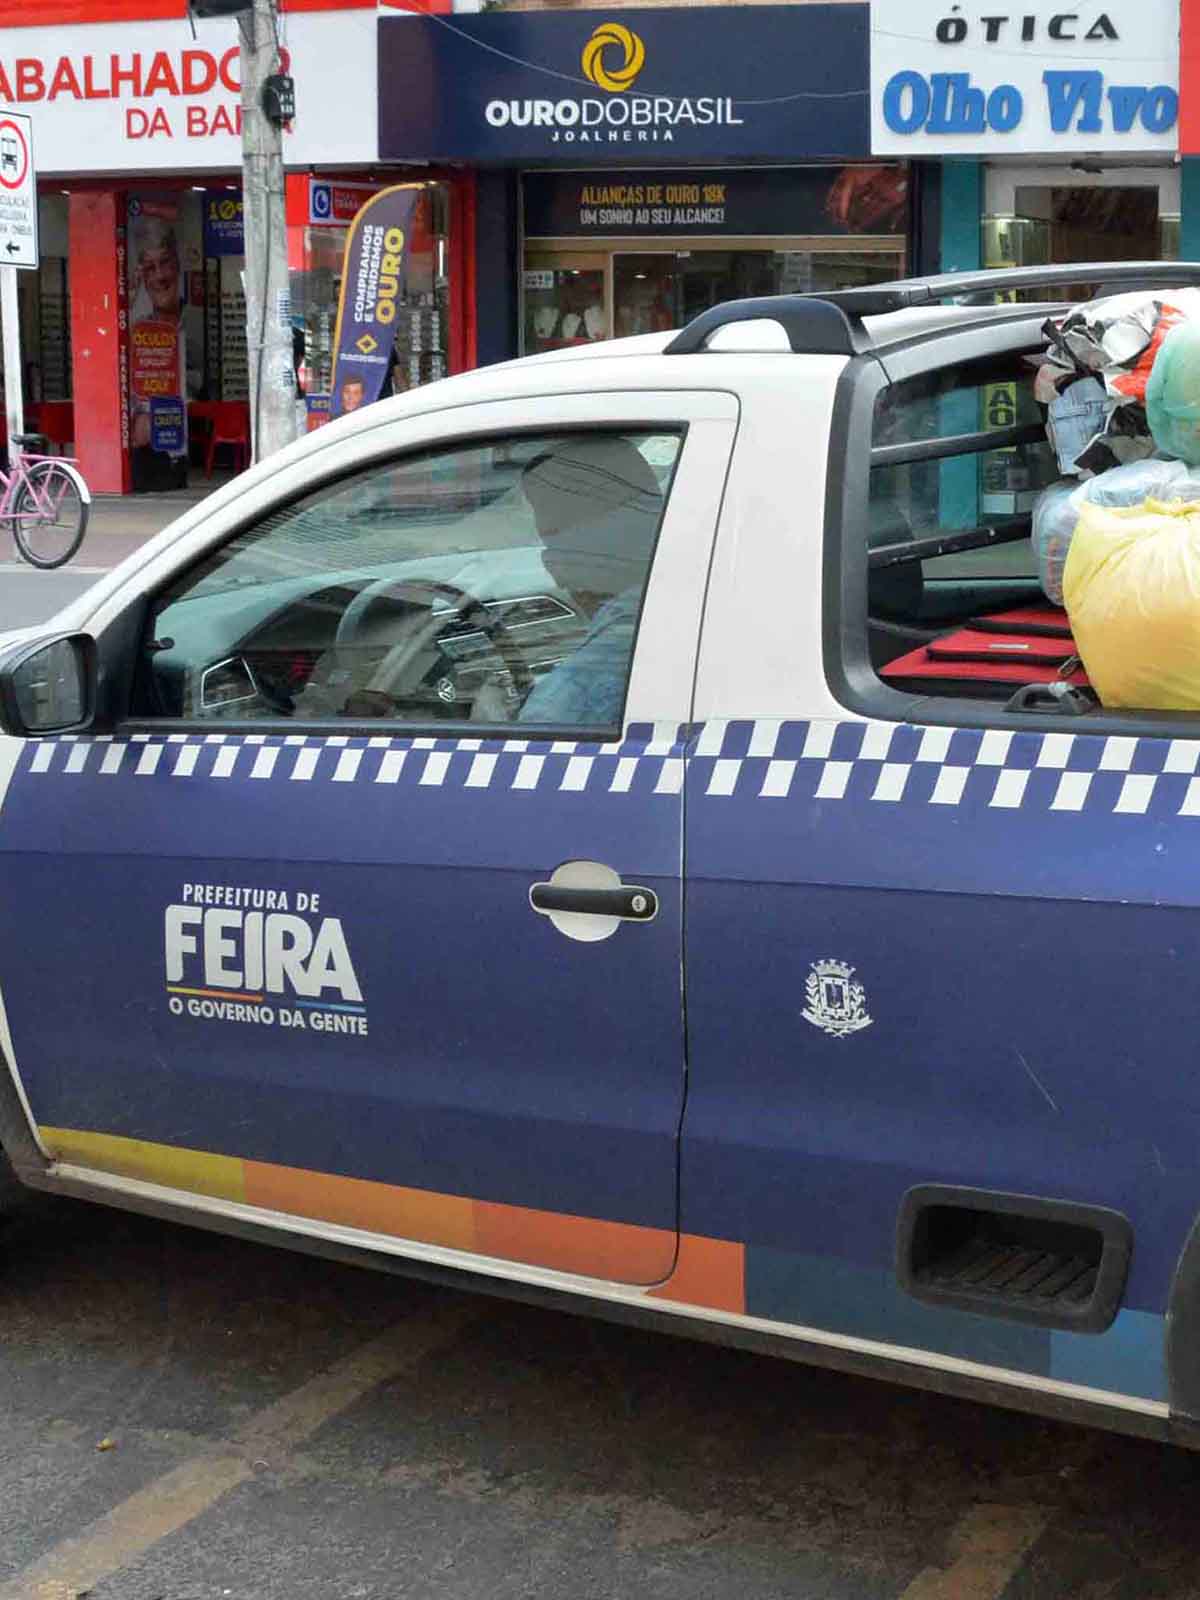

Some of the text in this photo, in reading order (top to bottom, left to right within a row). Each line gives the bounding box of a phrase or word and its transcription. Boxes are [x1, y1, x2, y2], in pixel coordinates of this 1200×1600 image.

[935, 5, 1119, 43] ÓTICA
[883, 69, 1025, 135] Olho
[126, 108, 173, 139] DA
[551, 129, 674, 142] JOALHERIA
[646, 186, 662, 203] DE
[666, 186, 699, 204] OURO
[354, 224, 374, 323] COMPRAMOS
[366, 226, 385, 310] VENDEMOS
[375, 227, 405, 325] OURO
[183, 883, 321, 913] PREFEITURA DE
[164, 904, 364, 1003] FEIRA
[168, 997, 369, 1036] O GOVERNO DA GENTE
